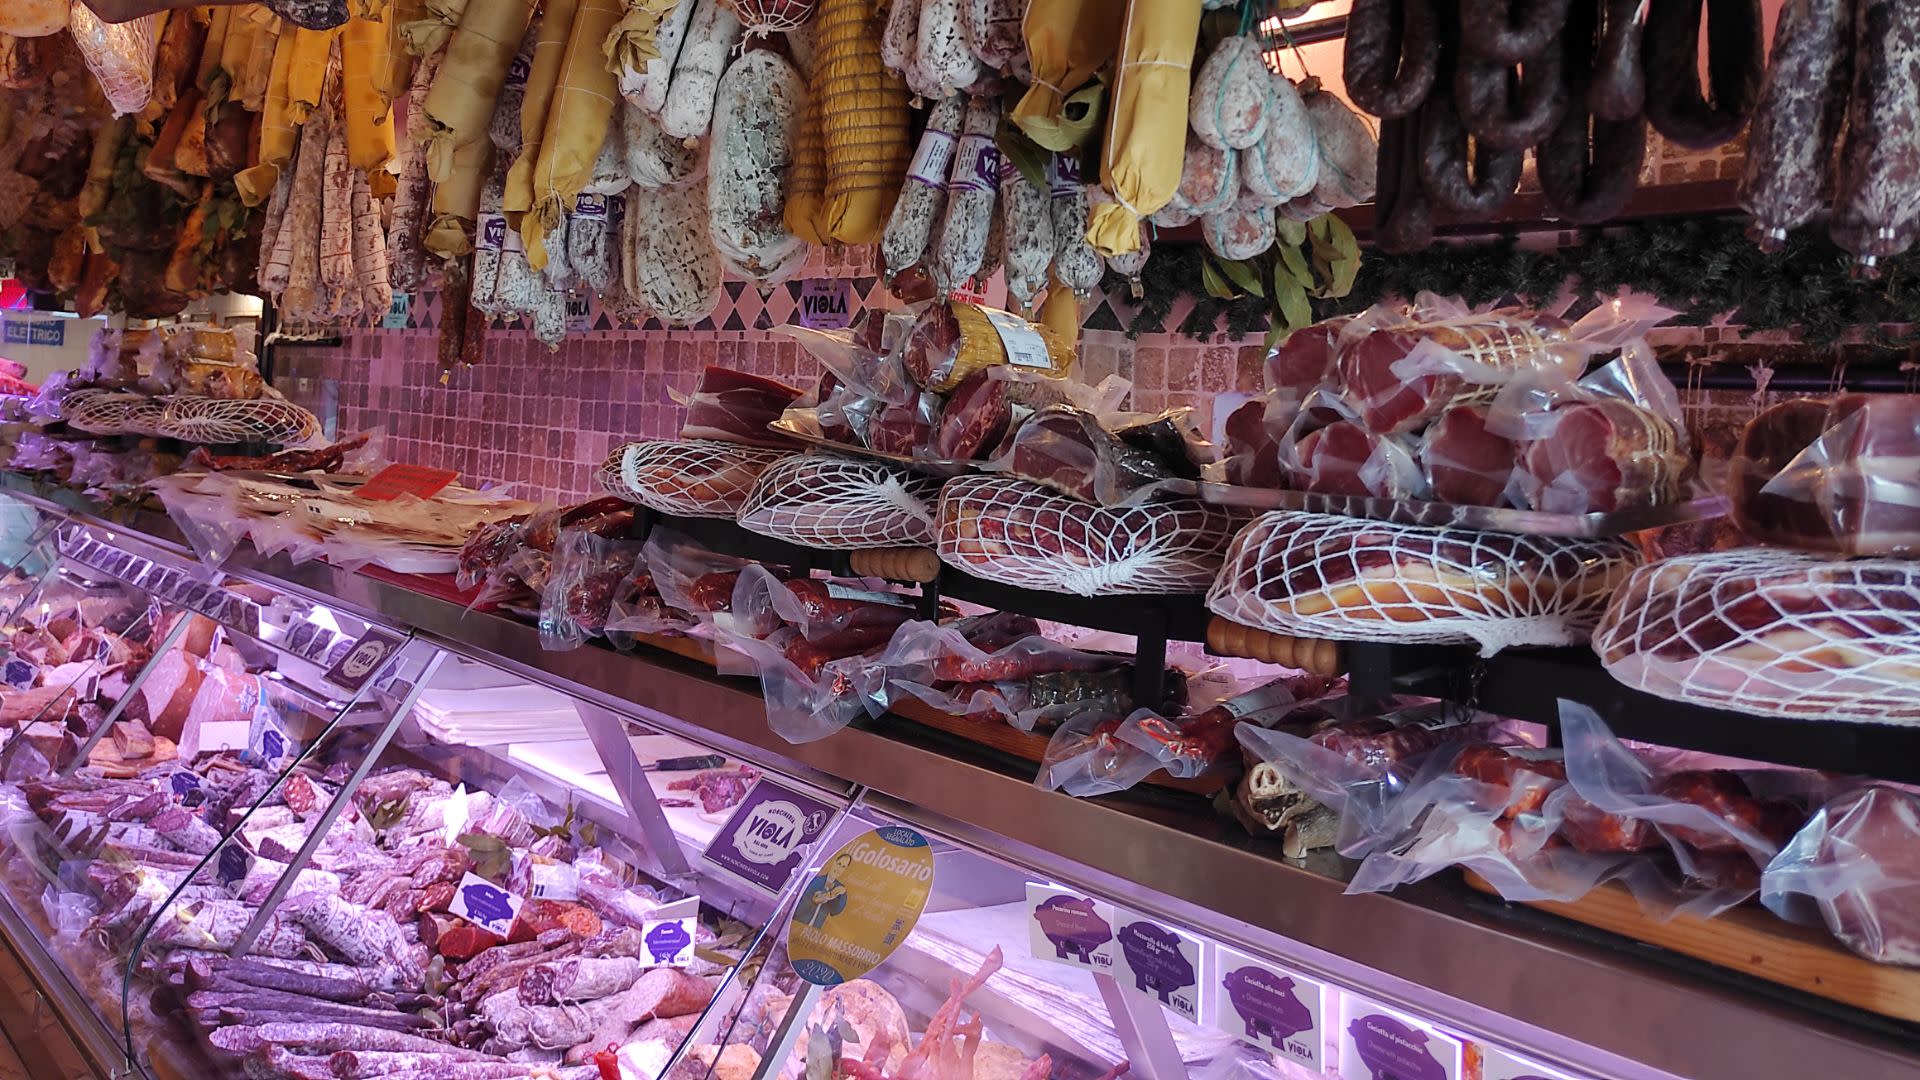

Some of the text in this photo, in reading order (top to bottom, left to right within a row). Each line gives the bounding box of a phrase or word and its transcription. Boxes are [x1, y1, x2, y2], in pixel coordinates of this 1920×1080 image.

[803, 290, 848, 318] VIOLA
[351, 650, 377, 667] VIOLA
[767, 808, 797, 824] NORCINERIA
[746, 815, 796, 849] VIOLA
[884, 833, 916, 846] SEGNALATO
[893, 829, 914, 838] LOCALE
[852, 842, 932, 881] Golosario
[800, 927, 828, 945] PAOLO
[827, 936, 881, 964] MASSOBRIO
[802, 961, 835, 982] 2020
[1244, 975, 1264, 990] Caciotta
[1264, 984, 1274, 993] alle
[1172, 994, 1194, 1016] VIOLA
[1366, 1021, 1388, 1038] Caciotta
[1395, 1036, 1423, 1054] pistacchio
[1287, 1041, 1313, 1060] VIOLA
